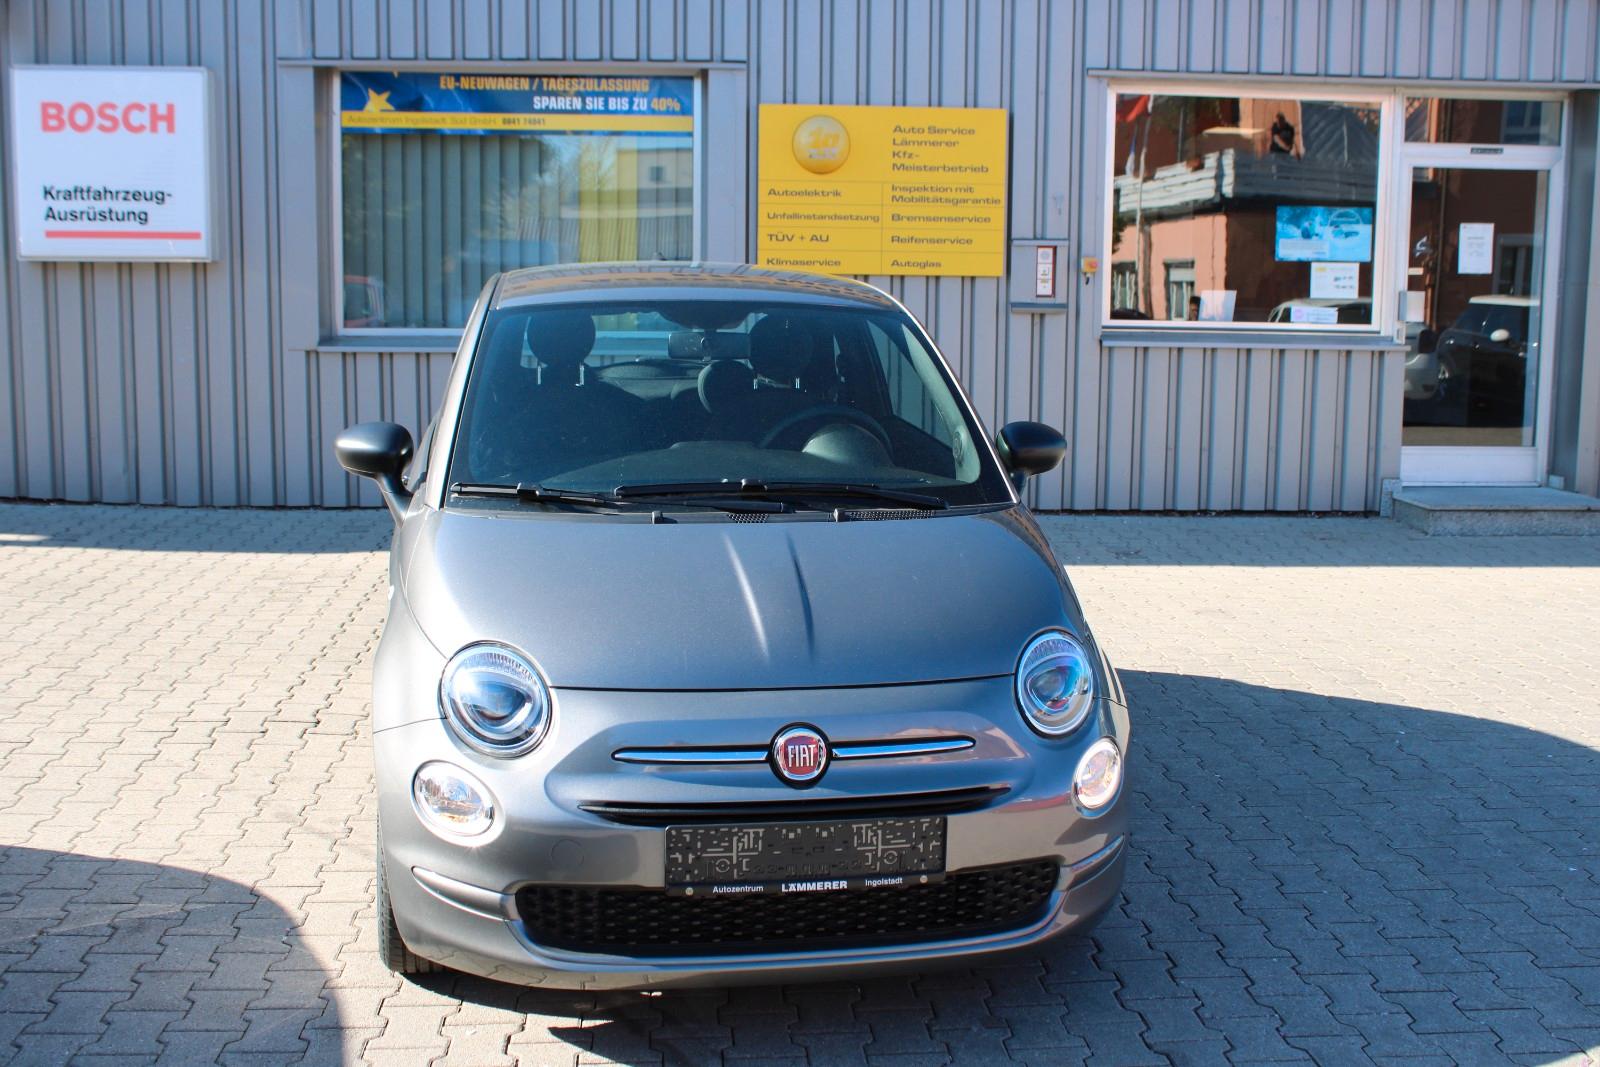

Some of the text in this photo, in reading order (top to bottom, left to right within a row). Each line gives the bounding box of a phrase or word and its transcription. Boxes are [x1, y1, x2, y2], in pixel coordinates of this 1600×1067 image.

[439, 75, 530, 91] EU-NEUWAGEN
[542, 78, 650, 93] TAGESZULASSUNG
[533, 96, 681, 112] SPAREN SIE BIS ZU 40%
[40, 101, 176, 134] BOSCH
[892, 125, 976, 135] Auto Service
[892, 138, 960, 147] Lämmerer
[892, 150, 920, 159] Kfz-
[892, 163, 989, 173] Meisterbetrieb
[767, 188, 842, 197] Autoelektrik
[891, 184, 974, 194] Inspektion mit
[43, 186, 173, 205] Kraftfahrzeug-
[891, 195, 1001, 206] Mobilitätsgarantie
[45, 206, 149, 225] Ausrüstung
[767, 212, 880, 223] Unfallinstandsetzung
[891, 214, 991, 224] Bremsenservice
[767, 232, 795, 242] TÜV
[809, 234, 830, 242] AU
[891, 235, 973, 245] Reifenservice
[766, 258, 841, 267] Klimaservice
[891, 259, 942, 269] Autoglas
[787, 744, 816, 768] FIAT
[712, 876, 903, 894] Autozentrum LÄMMERER Ingolstadt
